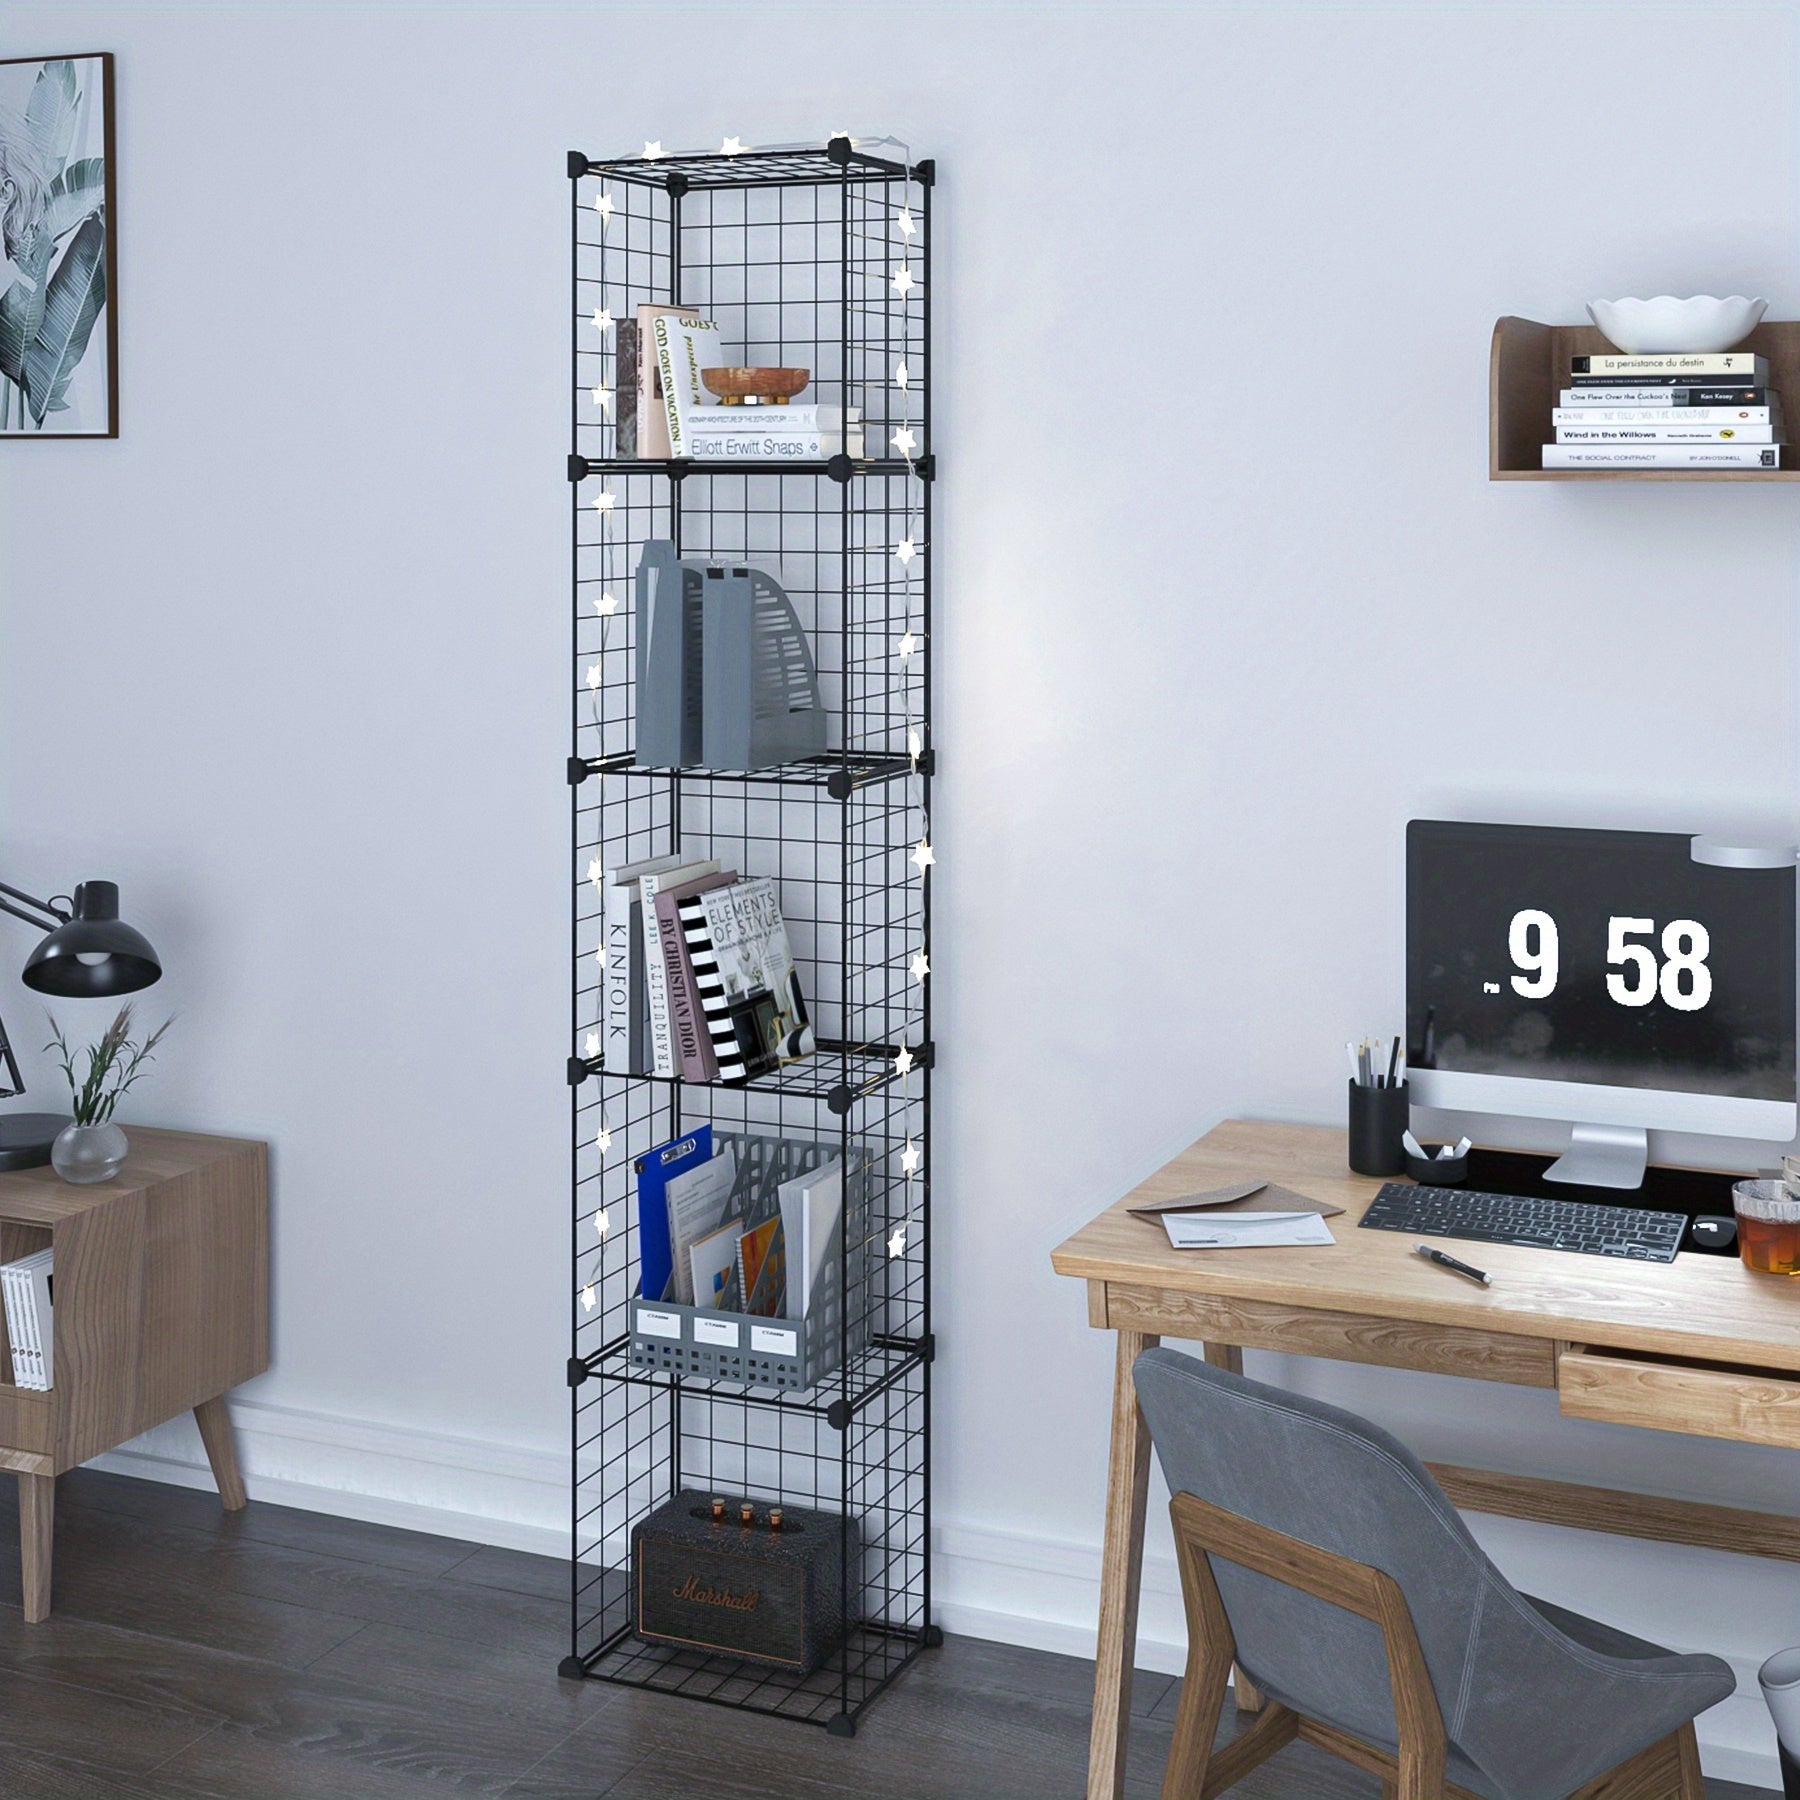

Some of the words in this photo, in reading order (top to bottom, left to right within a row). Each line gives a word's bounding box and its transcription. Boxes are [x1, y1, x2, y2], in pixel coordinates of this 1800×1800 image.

[655, 318, 668, 347] GOD
[660, 350, 672, 376] GOES
[684, 335, 699, 391] Unexpected
[1605, 359, 1615, 368] La
[1617, 359, 1664, 369] persistance
[1666, 358, 1677, 368] du
[1679, 358, 1705, 367] destin
[664, 376, 674, 392] ON
[1571, 393, 1586, 401] One
[1624, 392, 1636, 400] the
[1637, 392, 1669, 400] Cuckoo's
[1714, 393, 1734, 401] Kesey
[666, 393, 681, 442] VACATION
[691, 438, 724, 456] Elliott
[726, 438, 761, 456] Erwitt
[763, 438, 804, 459] Snaps
[1563, 431, 1589, 439] Wind
[1591, 431, 1600, 439] in
[1602, 431, 1618, 439] the
[1619, 431, 1657, 439] Willows
[645, 878, 654, 905] COLE
[708, 891, 776, 926] ELEMENTS
[649, 926, 658, 945] LEE
[660, 918, 676, 938] BY
[713, 922, 733, 943] OF
[737, 909, 780, 936] STYLE
[1508, 908, 1560, 1000] 9
[1605, 916, 1713, 1012] 58
[610, 924, 626, 1039] KINFOLK
[664, 940, 690, 1020] CHRISTIAN
[650, 963, 670, 1071] TRANQUILITY
[678, 1022, 697, 1058] DIOR
[672, 1574, 761, 1612] Marshall
